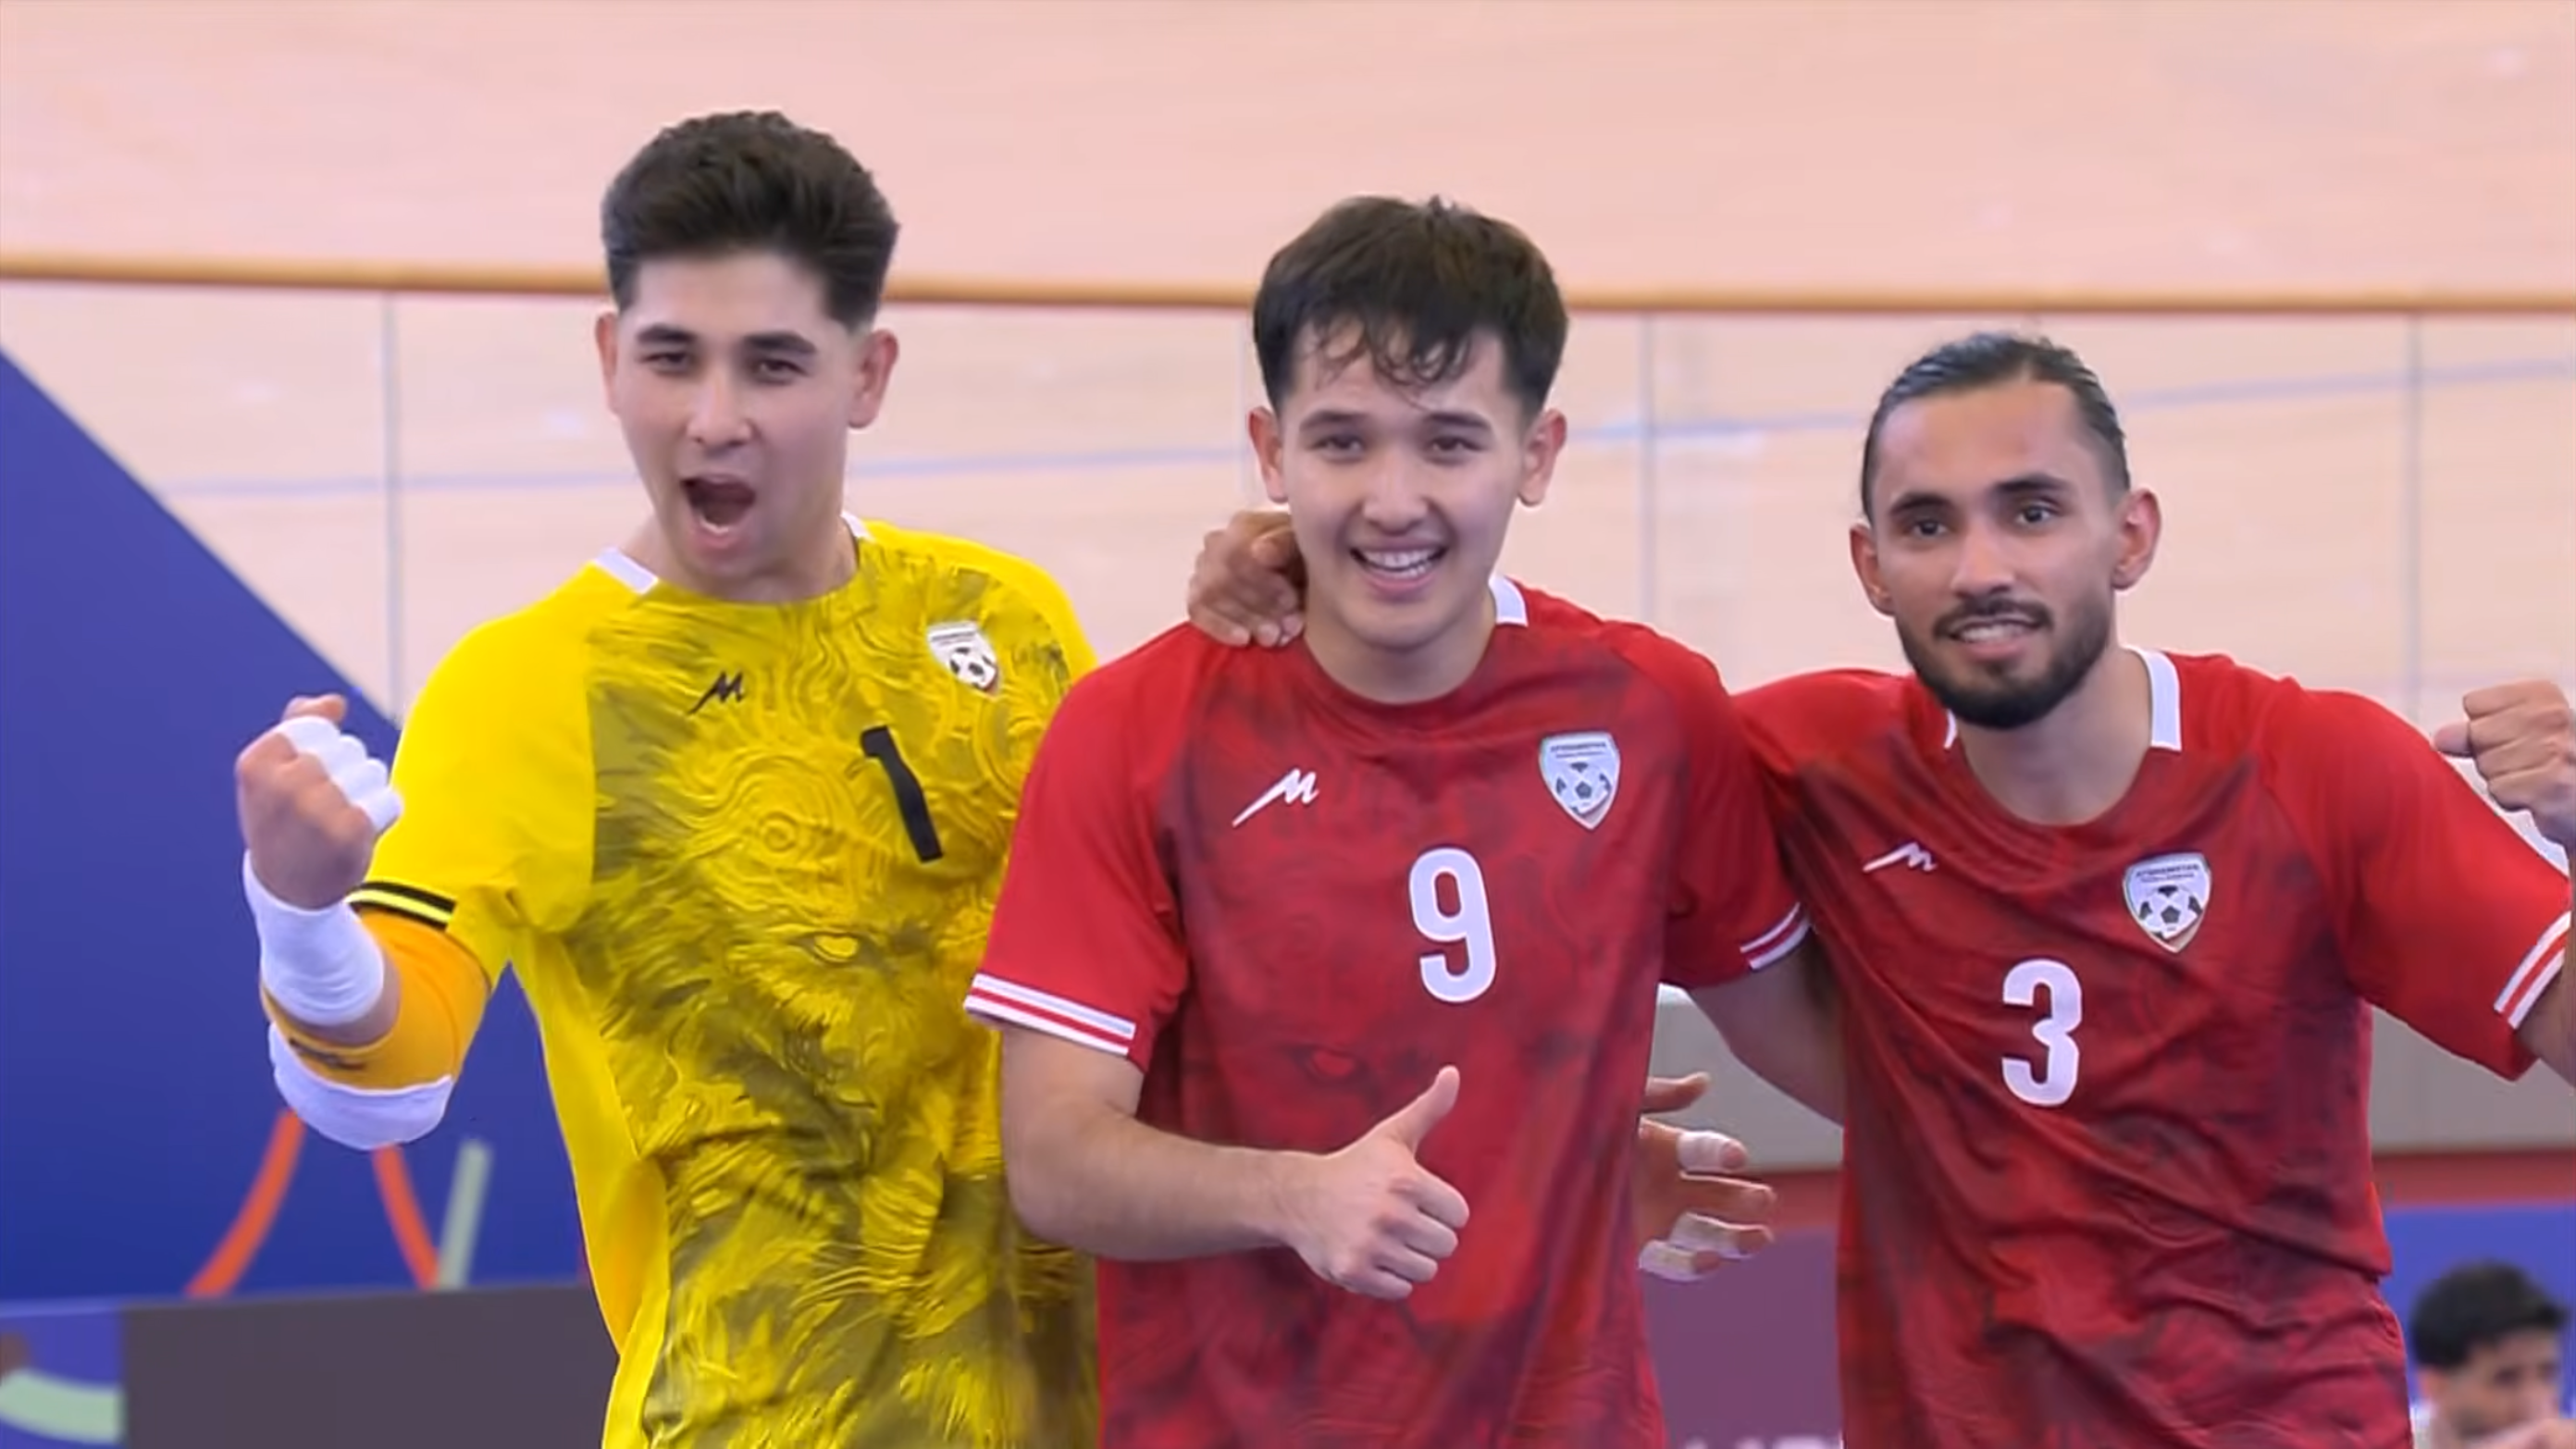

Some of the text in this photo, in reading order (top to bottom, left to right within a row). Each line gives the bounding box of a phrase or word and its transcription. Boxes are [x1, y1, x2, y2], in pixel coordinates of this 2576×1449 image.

[861, 725, 944, 863] 1
[1408, 847, 1497, 1003] 9
[2001, 959, 2083, 1107] 3
